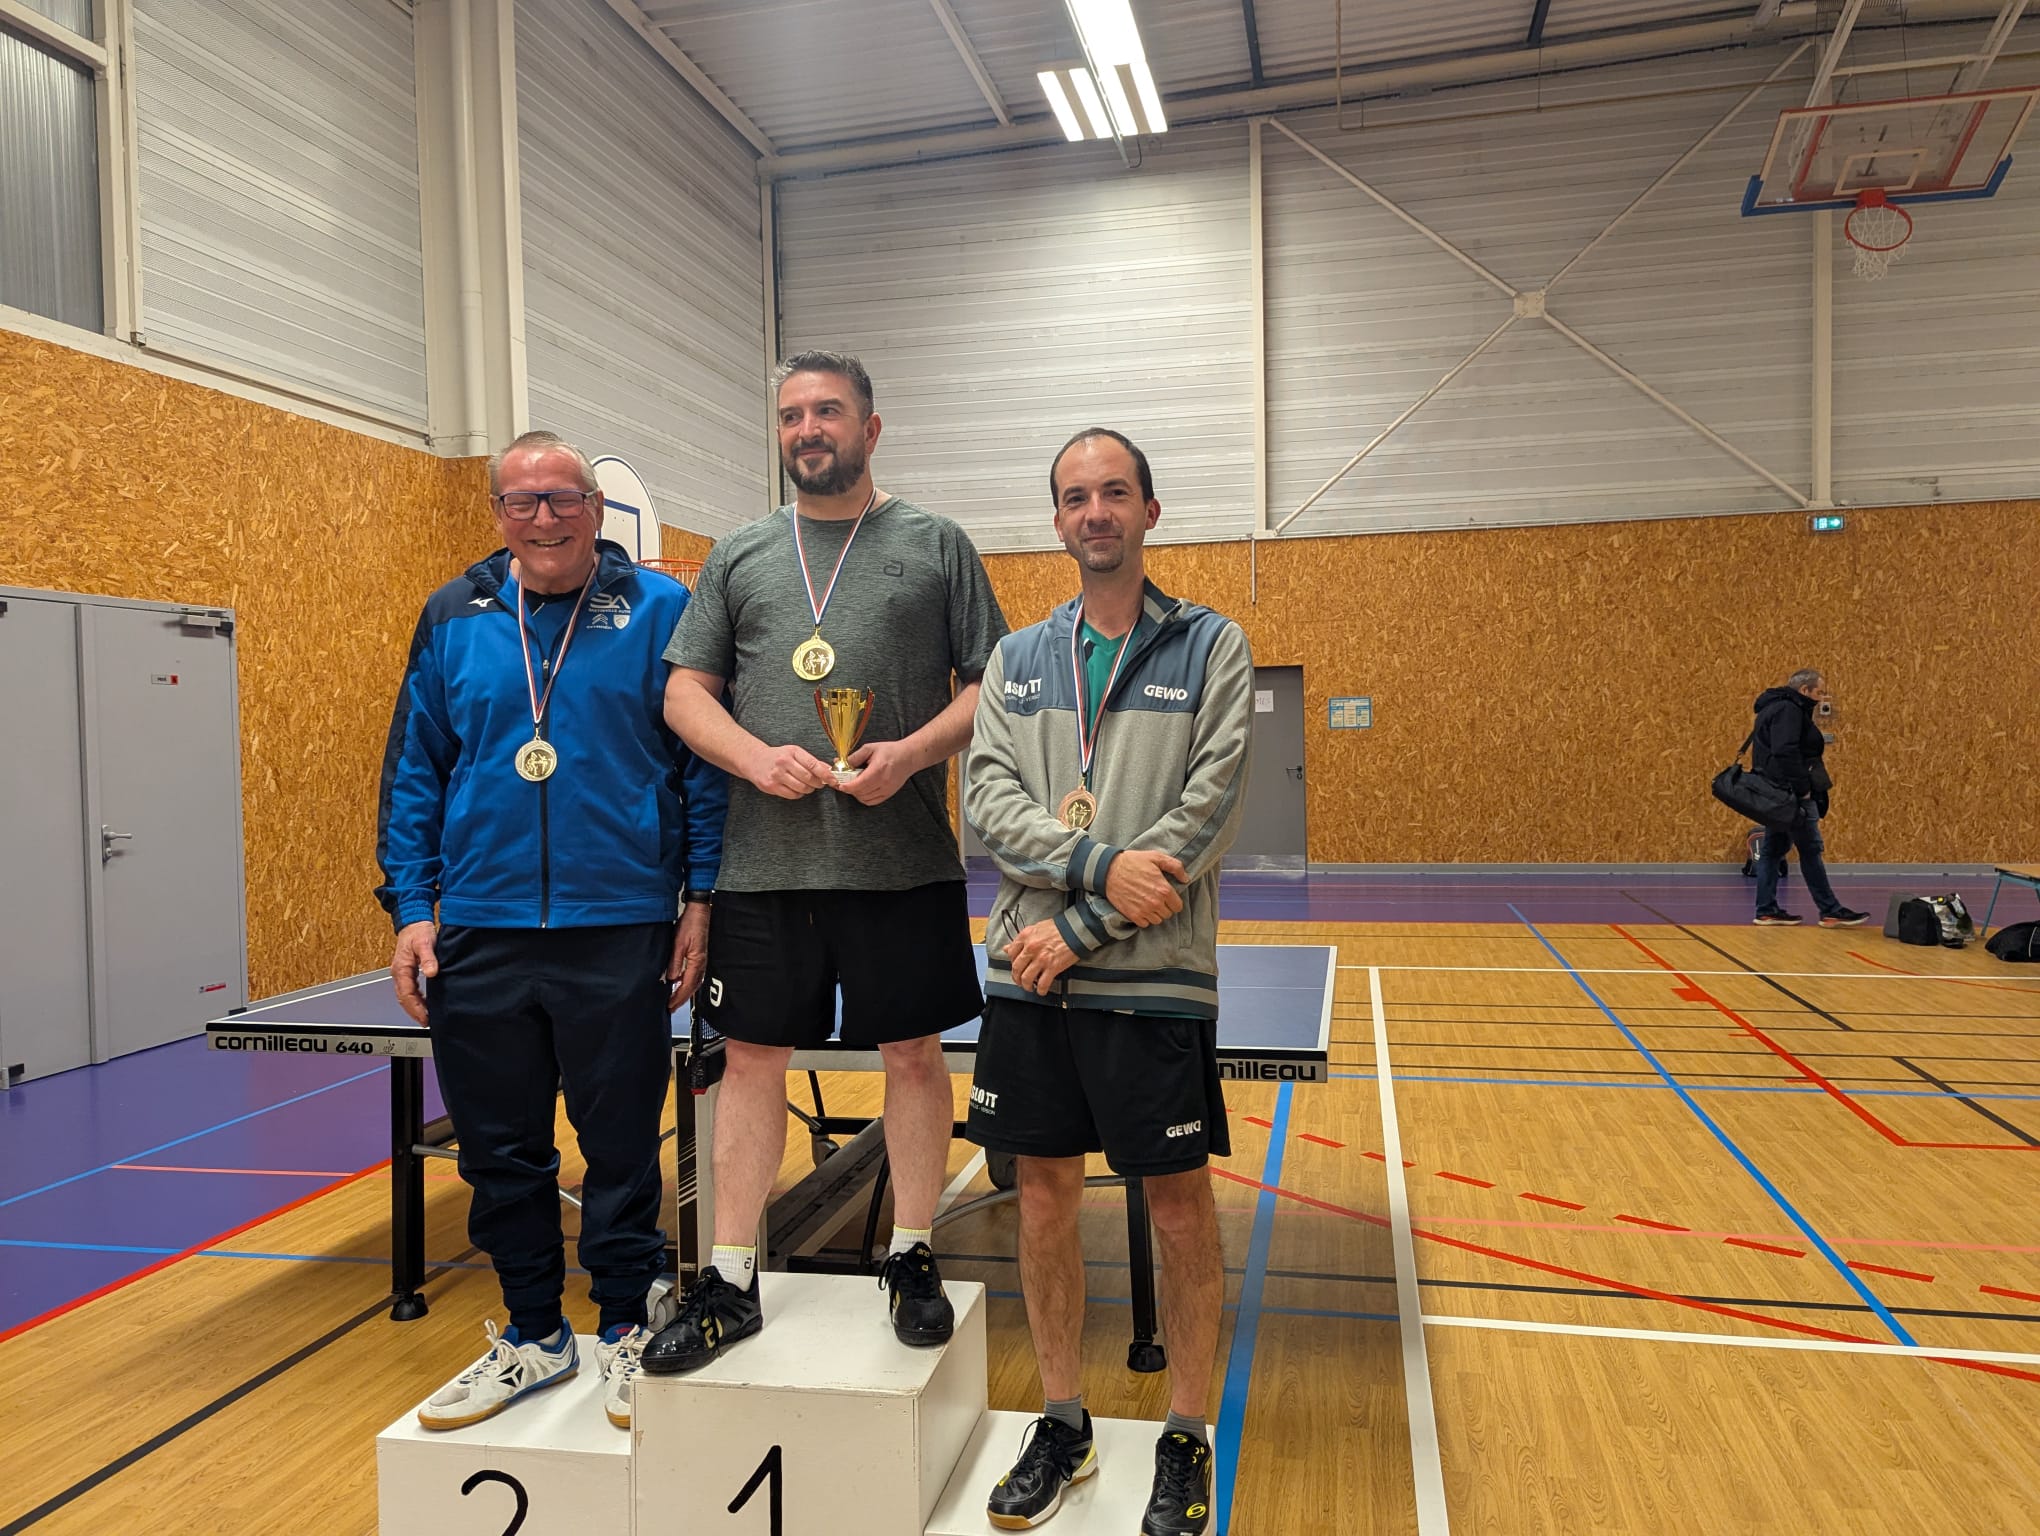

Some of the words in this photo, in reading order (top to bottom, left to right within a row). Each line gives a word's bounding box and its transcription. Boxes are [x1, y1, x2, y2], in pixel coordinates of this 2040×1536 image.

[1143, 684, 1189, 701] GEWO
[215, 1035, 328, 1053] cornilleau
[335, 1041, 374, 1054] 640
[1218, 1060, 1316, 1080] nilleau
[970, 1084, 999, 1109] SLOTT
[1165, 1119, 1202, 1138] GEWO
[727, 1444, 782, 1536] 1
